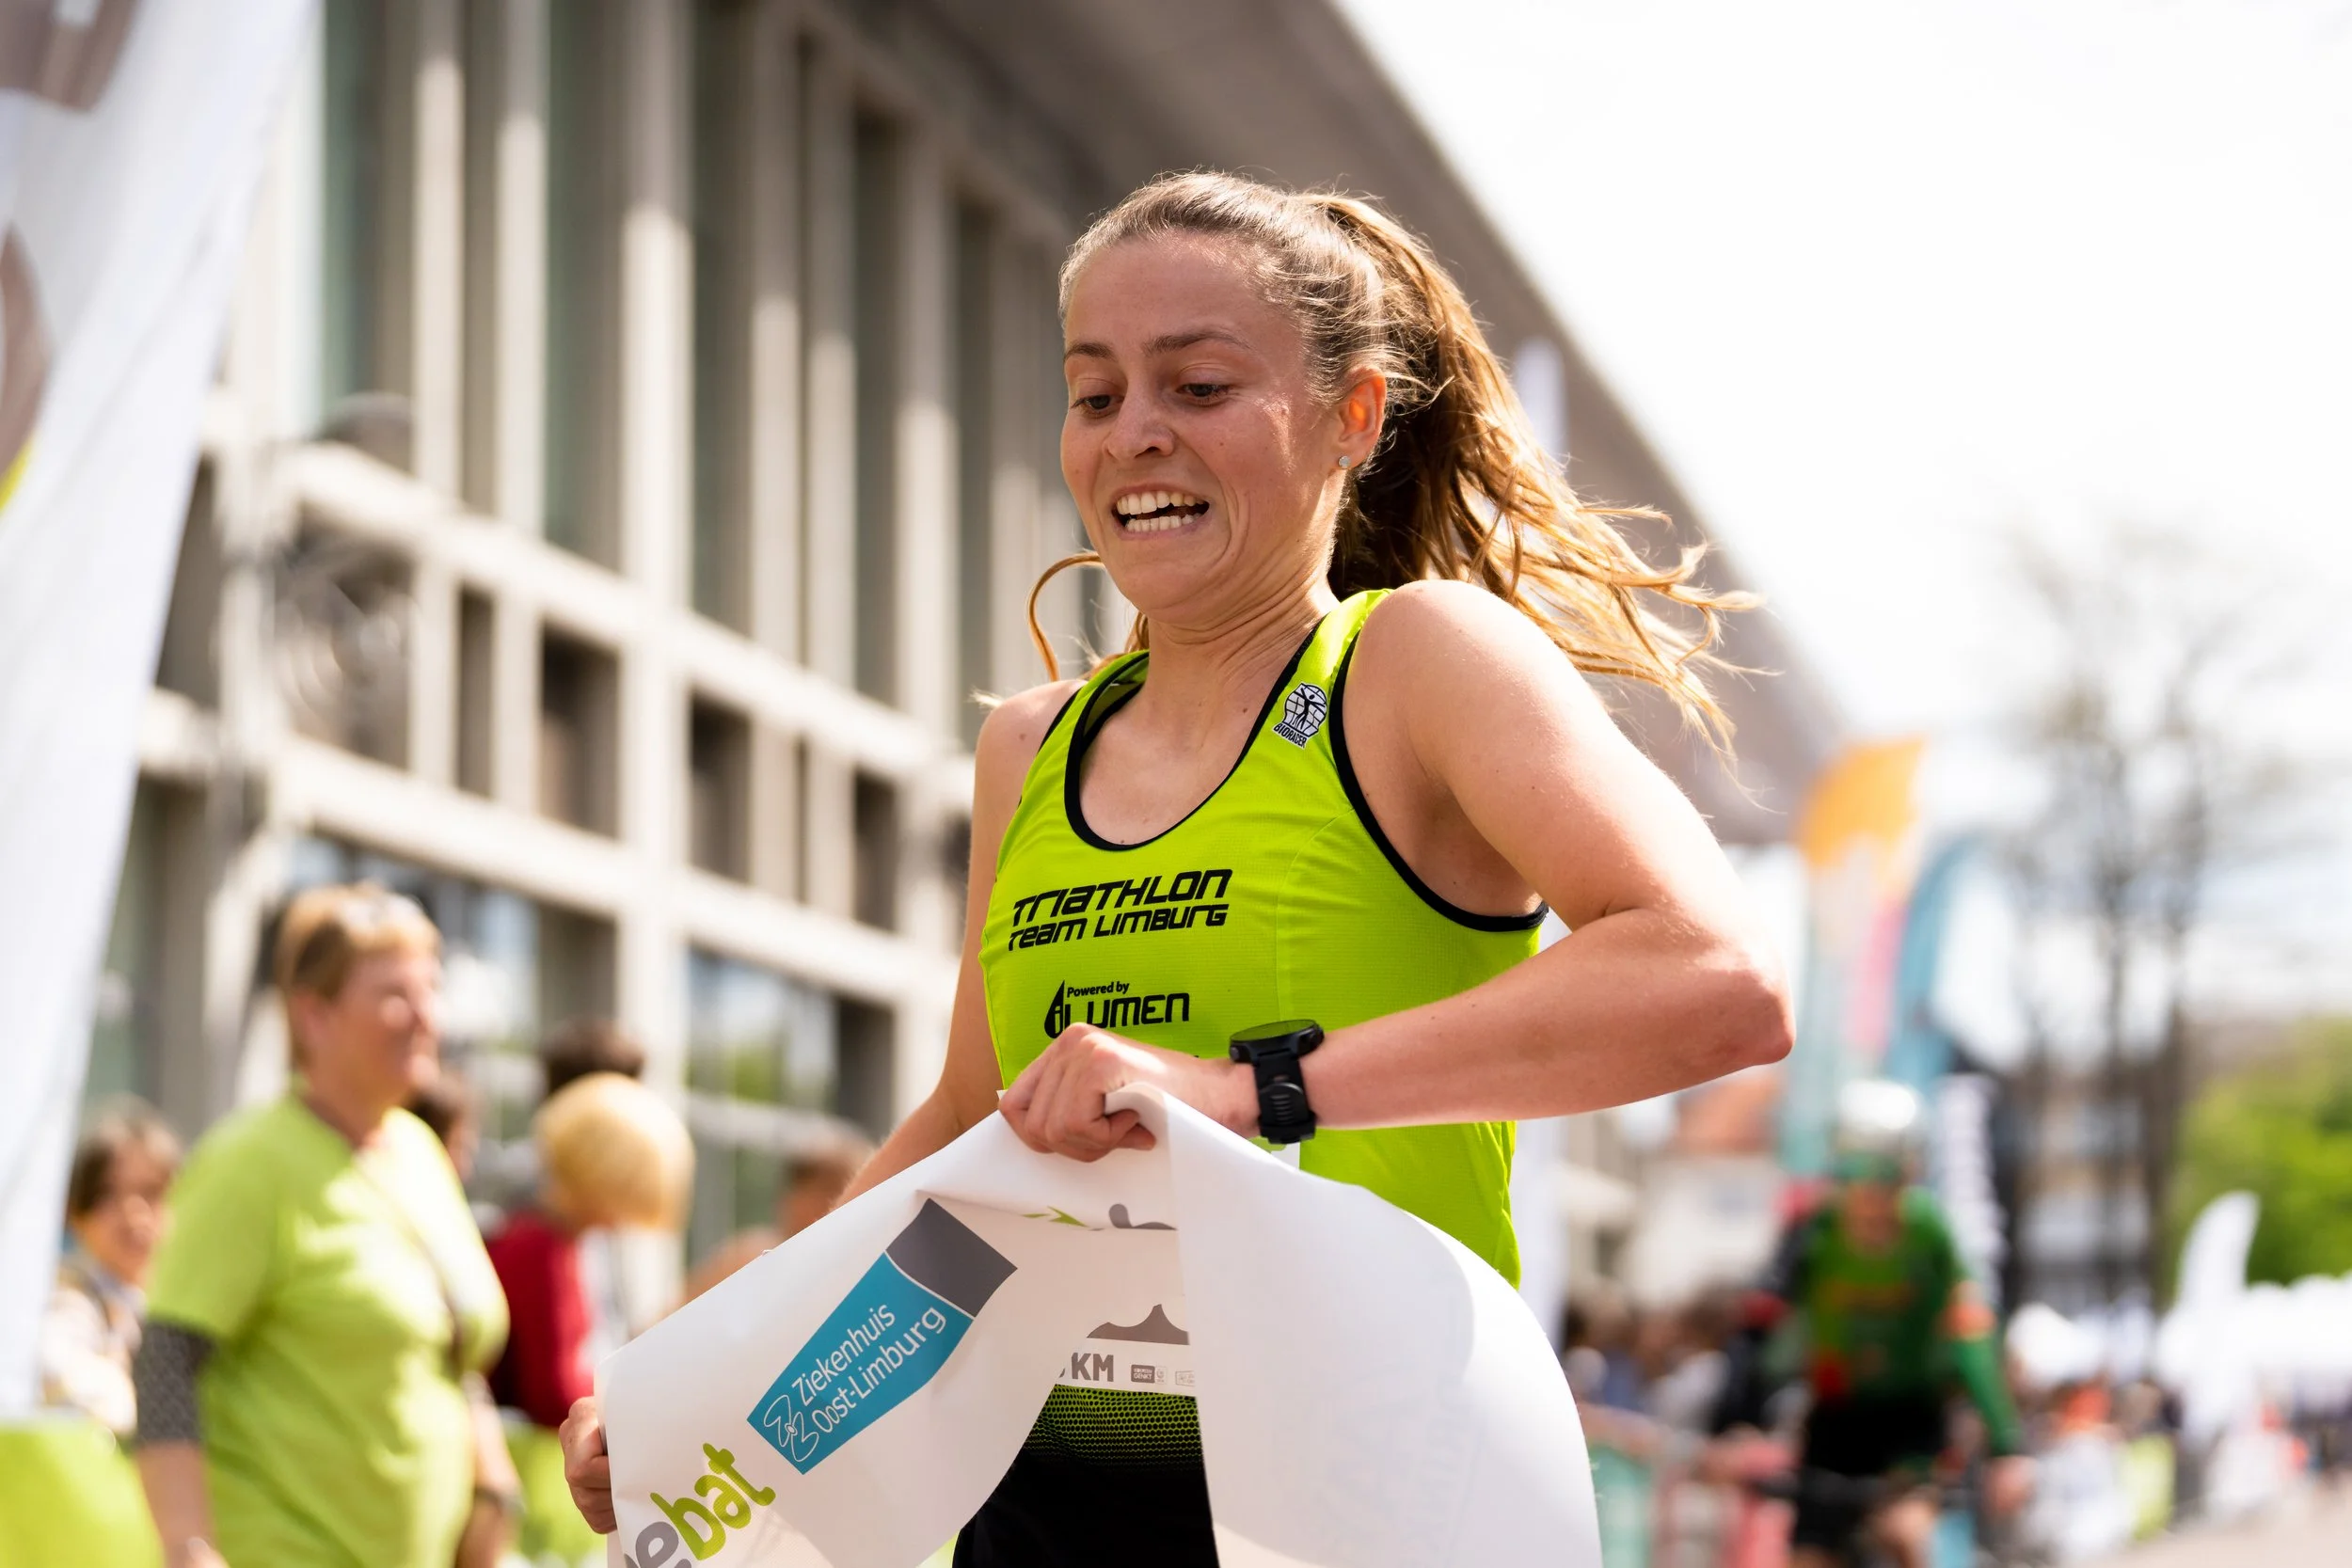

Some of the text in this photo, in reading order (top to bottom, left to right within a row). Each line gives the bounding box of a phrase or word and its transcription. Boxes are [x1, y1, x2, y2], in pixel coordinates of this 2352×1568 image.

[1273, 723, 1308, 748] BIORACER
[1092, 903, 1230, 937] LIMBURG
[1066, 981, 1130, 998] Powered by
[791, 1304, 896, 1407] Ziekenhuis
[811, 1307, 947, 1433] Oost-Limburg
[1071, 1352, 1114, 1382] KM
